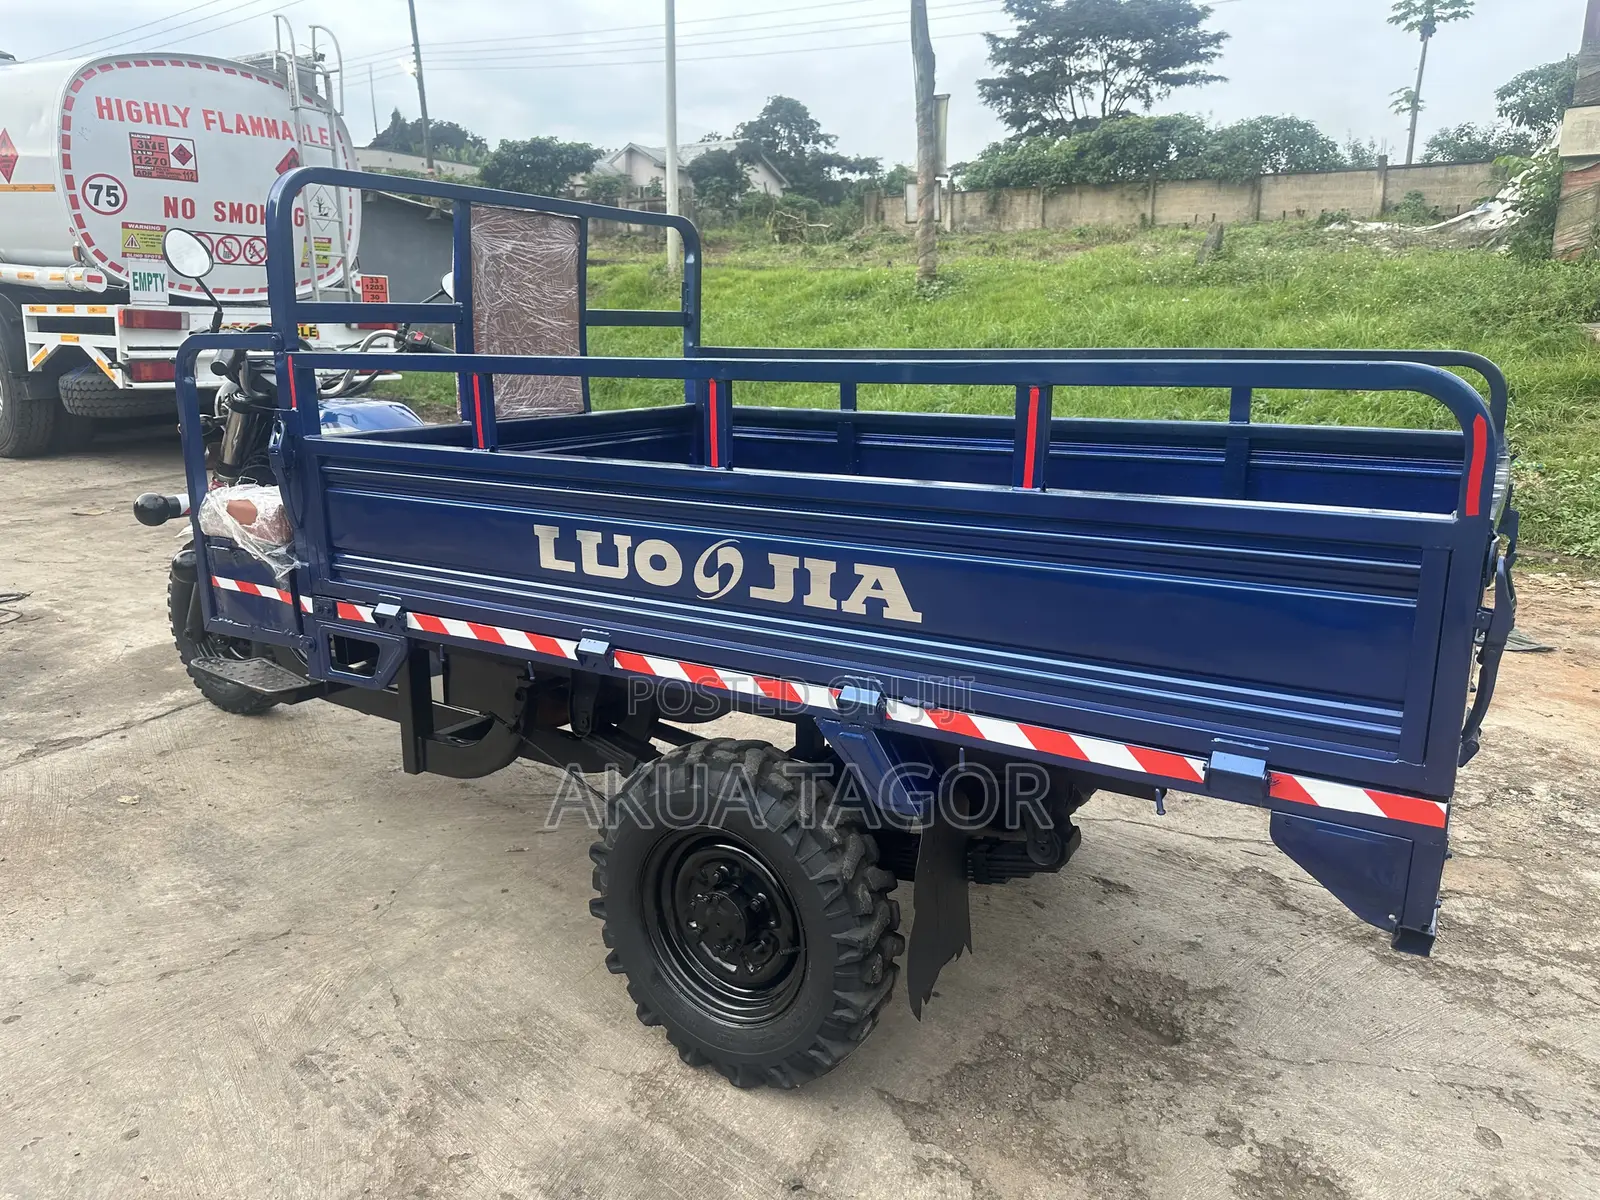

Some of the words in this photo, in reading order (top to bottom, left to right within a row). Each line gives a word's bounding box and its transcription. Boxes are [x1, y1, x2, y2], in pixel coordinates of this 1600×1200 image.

[95, 96, 190, 128] HIGHLY
[136, 155, 168, 166] 1270
[88, 183, 120, 208] 75
[163, 196, 196, 219] NO
[127, 223, 161, 231] WARNING
[132, 271, 166, 292] EMPTY
[533, 524, 683, 587] LUO
[749, 552, 923, 624] JIA
